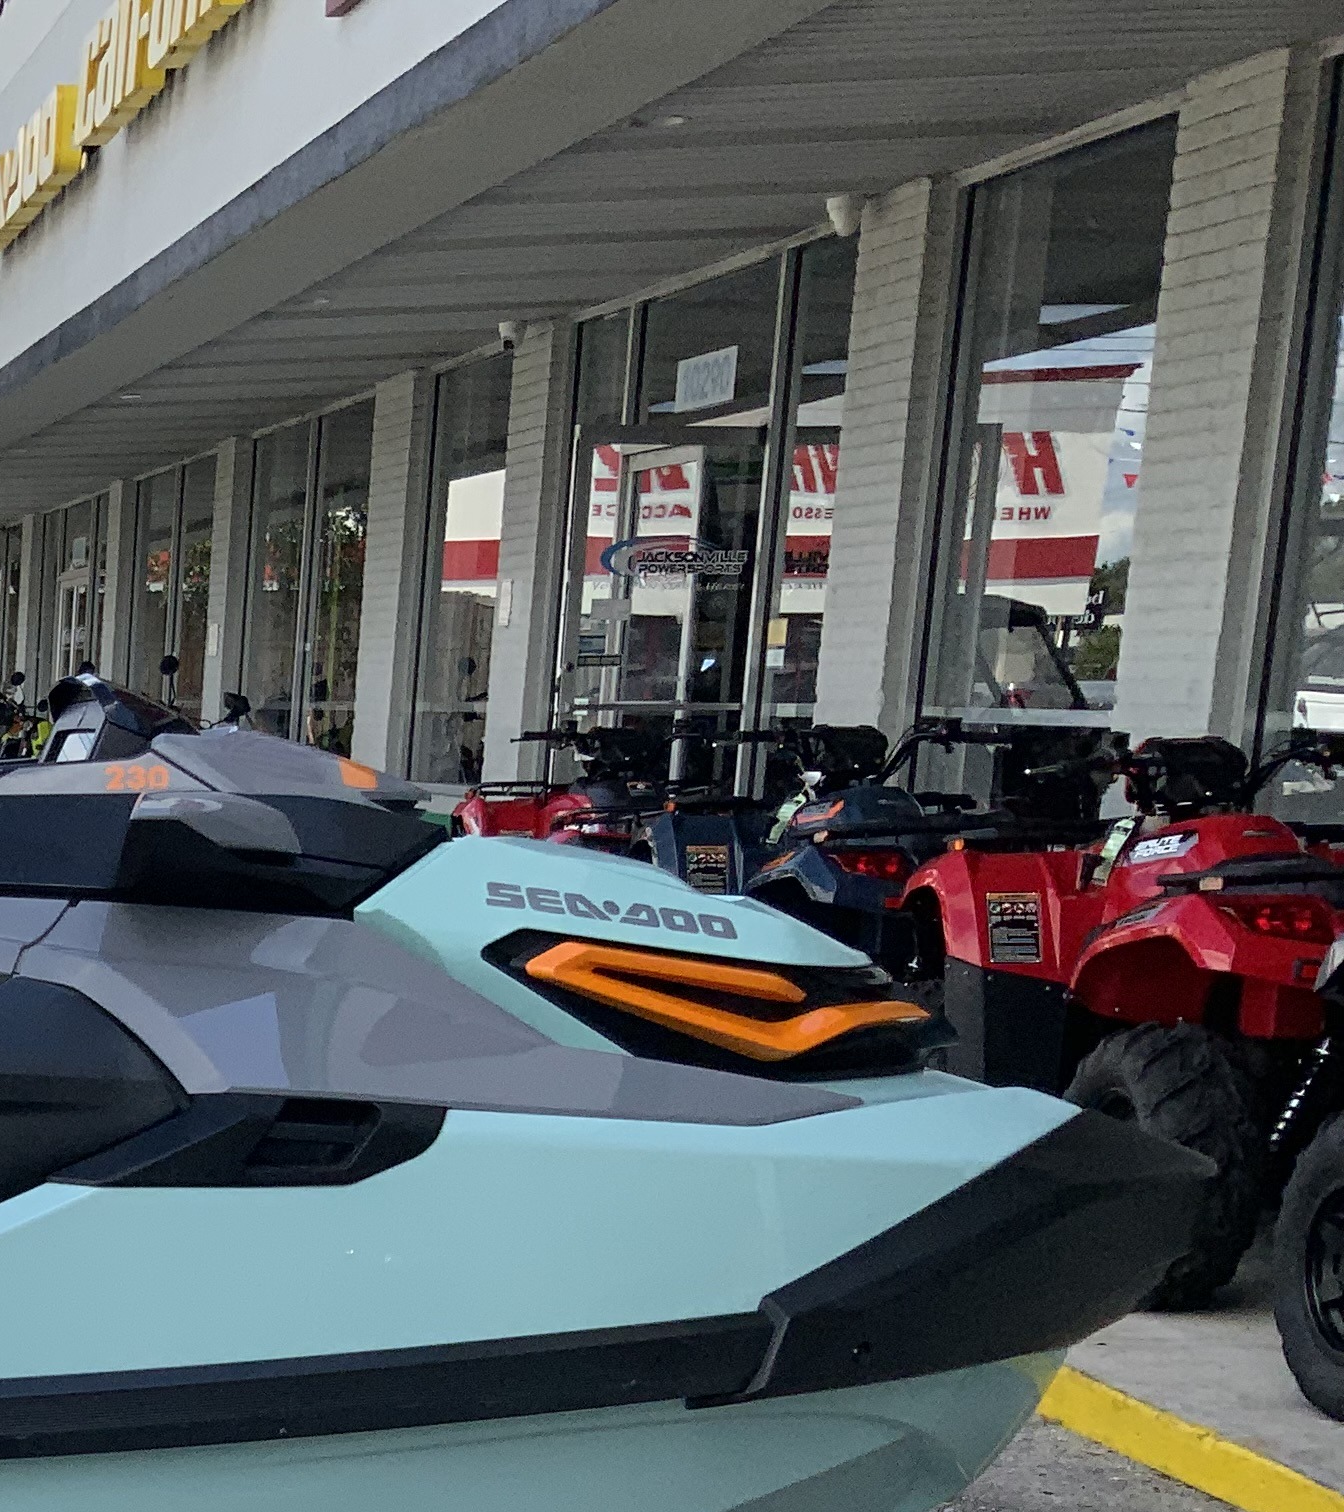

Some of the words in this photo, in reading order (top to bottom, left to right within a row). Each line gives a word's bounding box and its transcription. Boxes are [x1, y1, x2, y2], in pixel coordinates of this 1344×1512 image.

[636, 550, 749, 563] JACKSONVILLE
[638, 563, 743, 575] POWERSPORTS
[105, 765, 170, 791] 230
